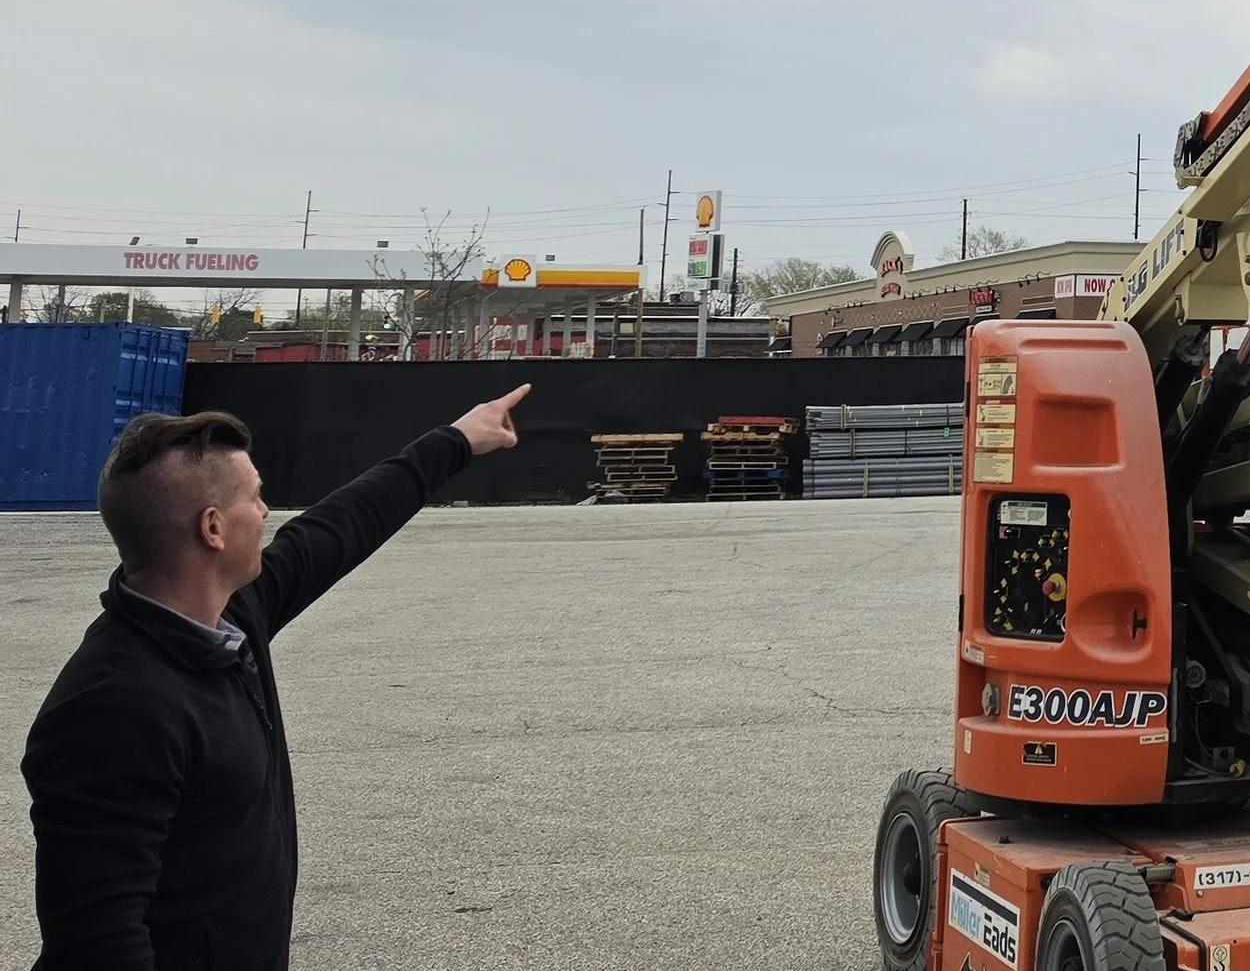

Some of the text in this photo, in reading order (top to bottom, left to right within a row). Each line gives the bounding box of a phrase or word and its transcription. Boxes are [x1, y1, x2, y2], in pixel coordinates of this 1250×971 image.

[124, 252, 259, 271] TRUCK FUELING
[1152, 217, 1185, 280] LIFT
[1084, 278, 1107, 293] NOW
[1007, 684, 1168, 727] E300AJP
[951, 891, 1016, 964] Miller Eads
